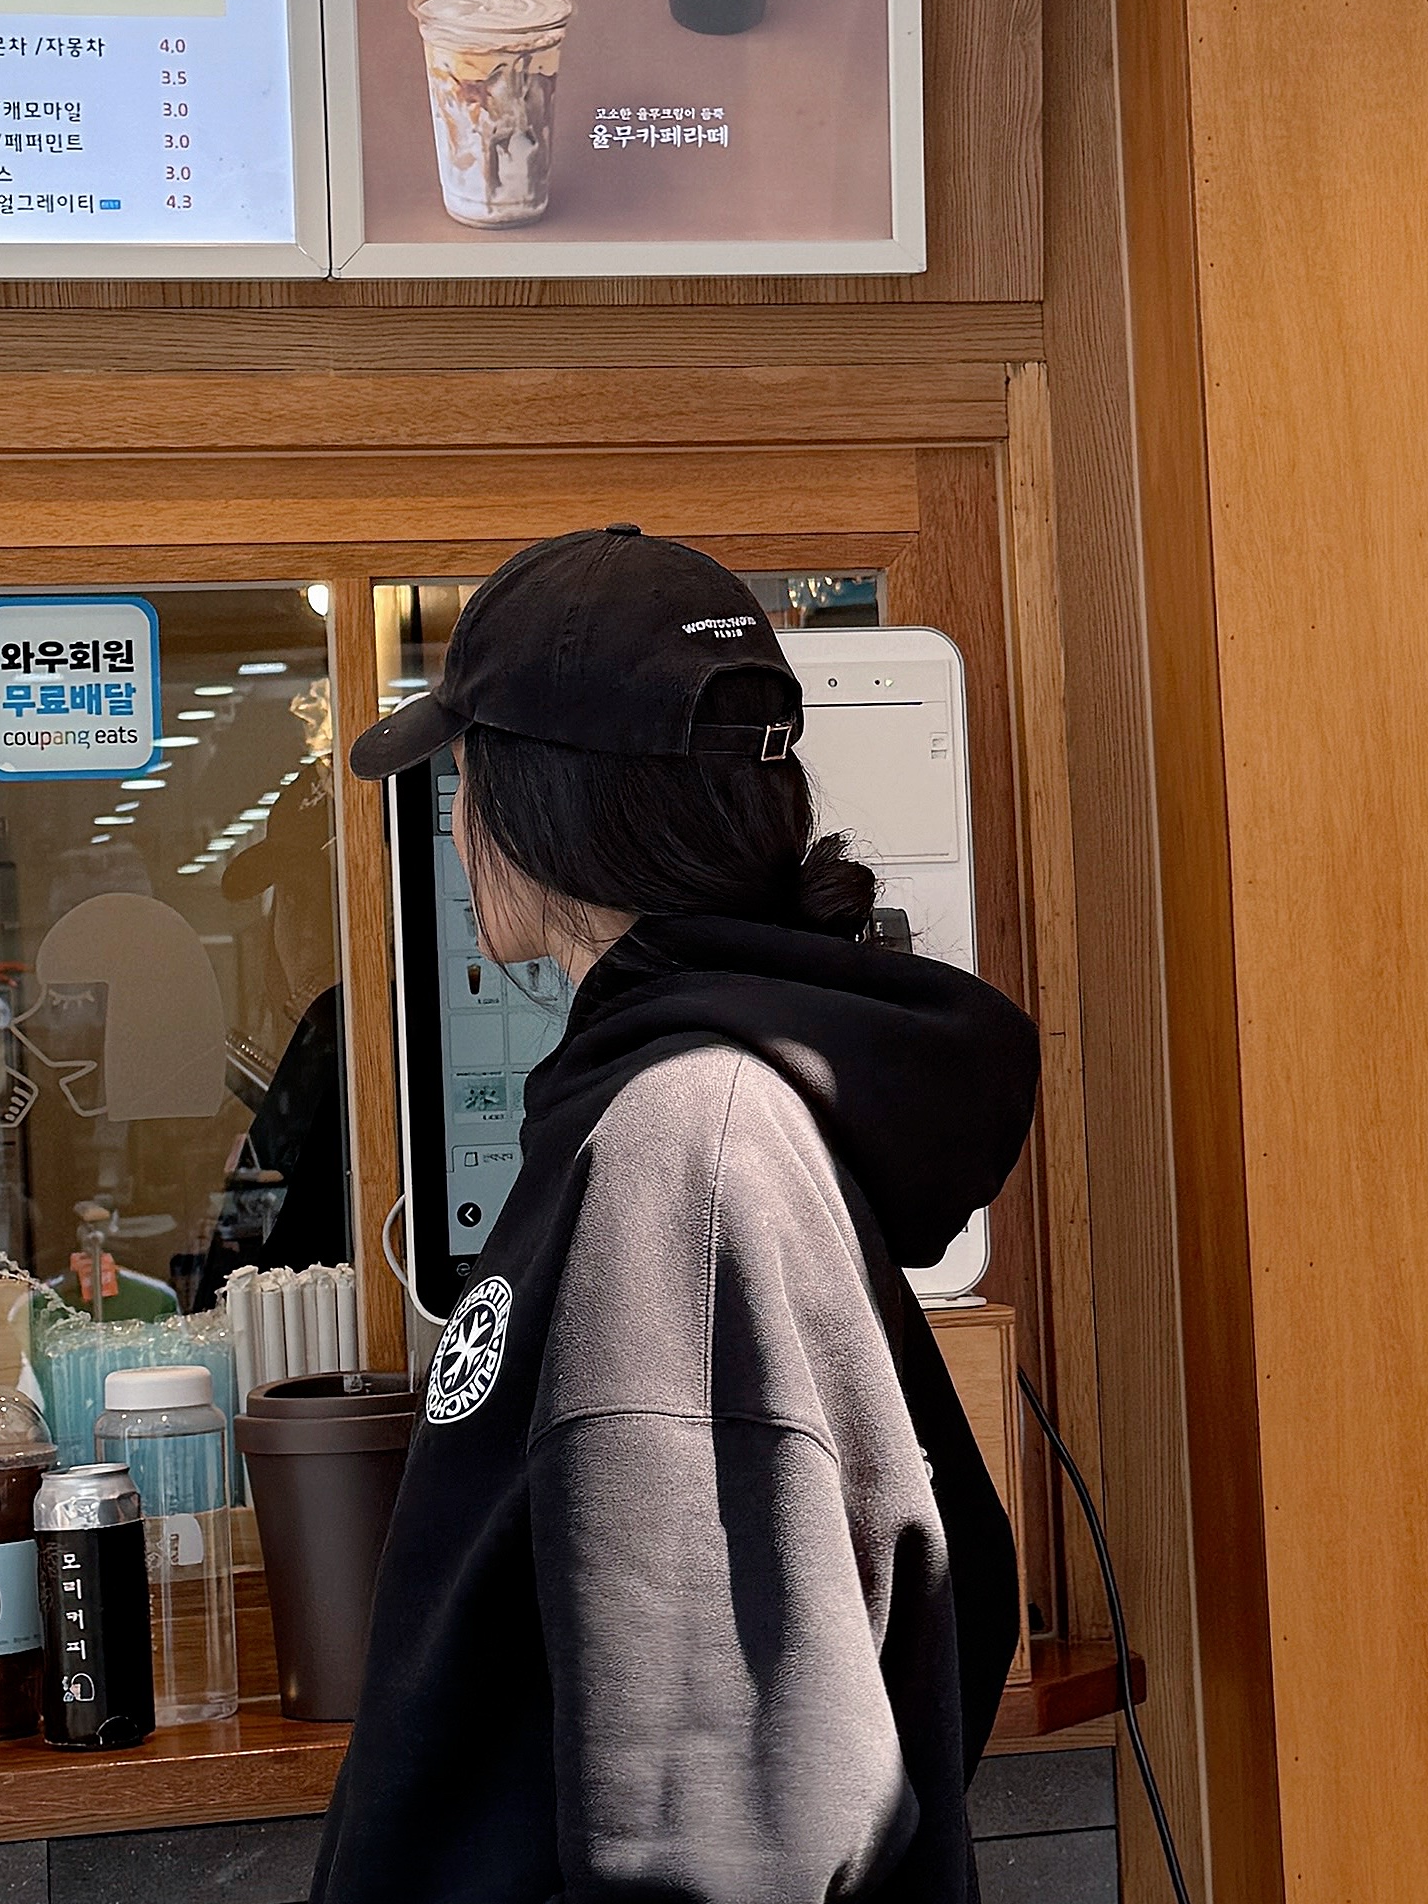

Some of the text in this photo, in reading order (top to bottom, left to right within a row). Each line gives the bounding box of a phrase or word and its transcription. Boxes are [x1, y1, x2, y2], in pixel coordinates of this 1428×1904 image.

[160, 39, 185, 53] 4.0
[162, 71, 186, 85] 3.5
[164, 103, 188, 117] 3.0
[165, 135, 189, 148] 3.0
[589, 124, 728, 148] 율무카페라떼
[166, 166, 190, 180] 3.0
[167, 195, 191, 208] 4.3
[1, 640, 134, 673] 와우회원
[3, 683, 136, 717] 무료배달
[3, 727, 138, 751] coupang eats
[62, 1554, 87, 1660] 모리커피
